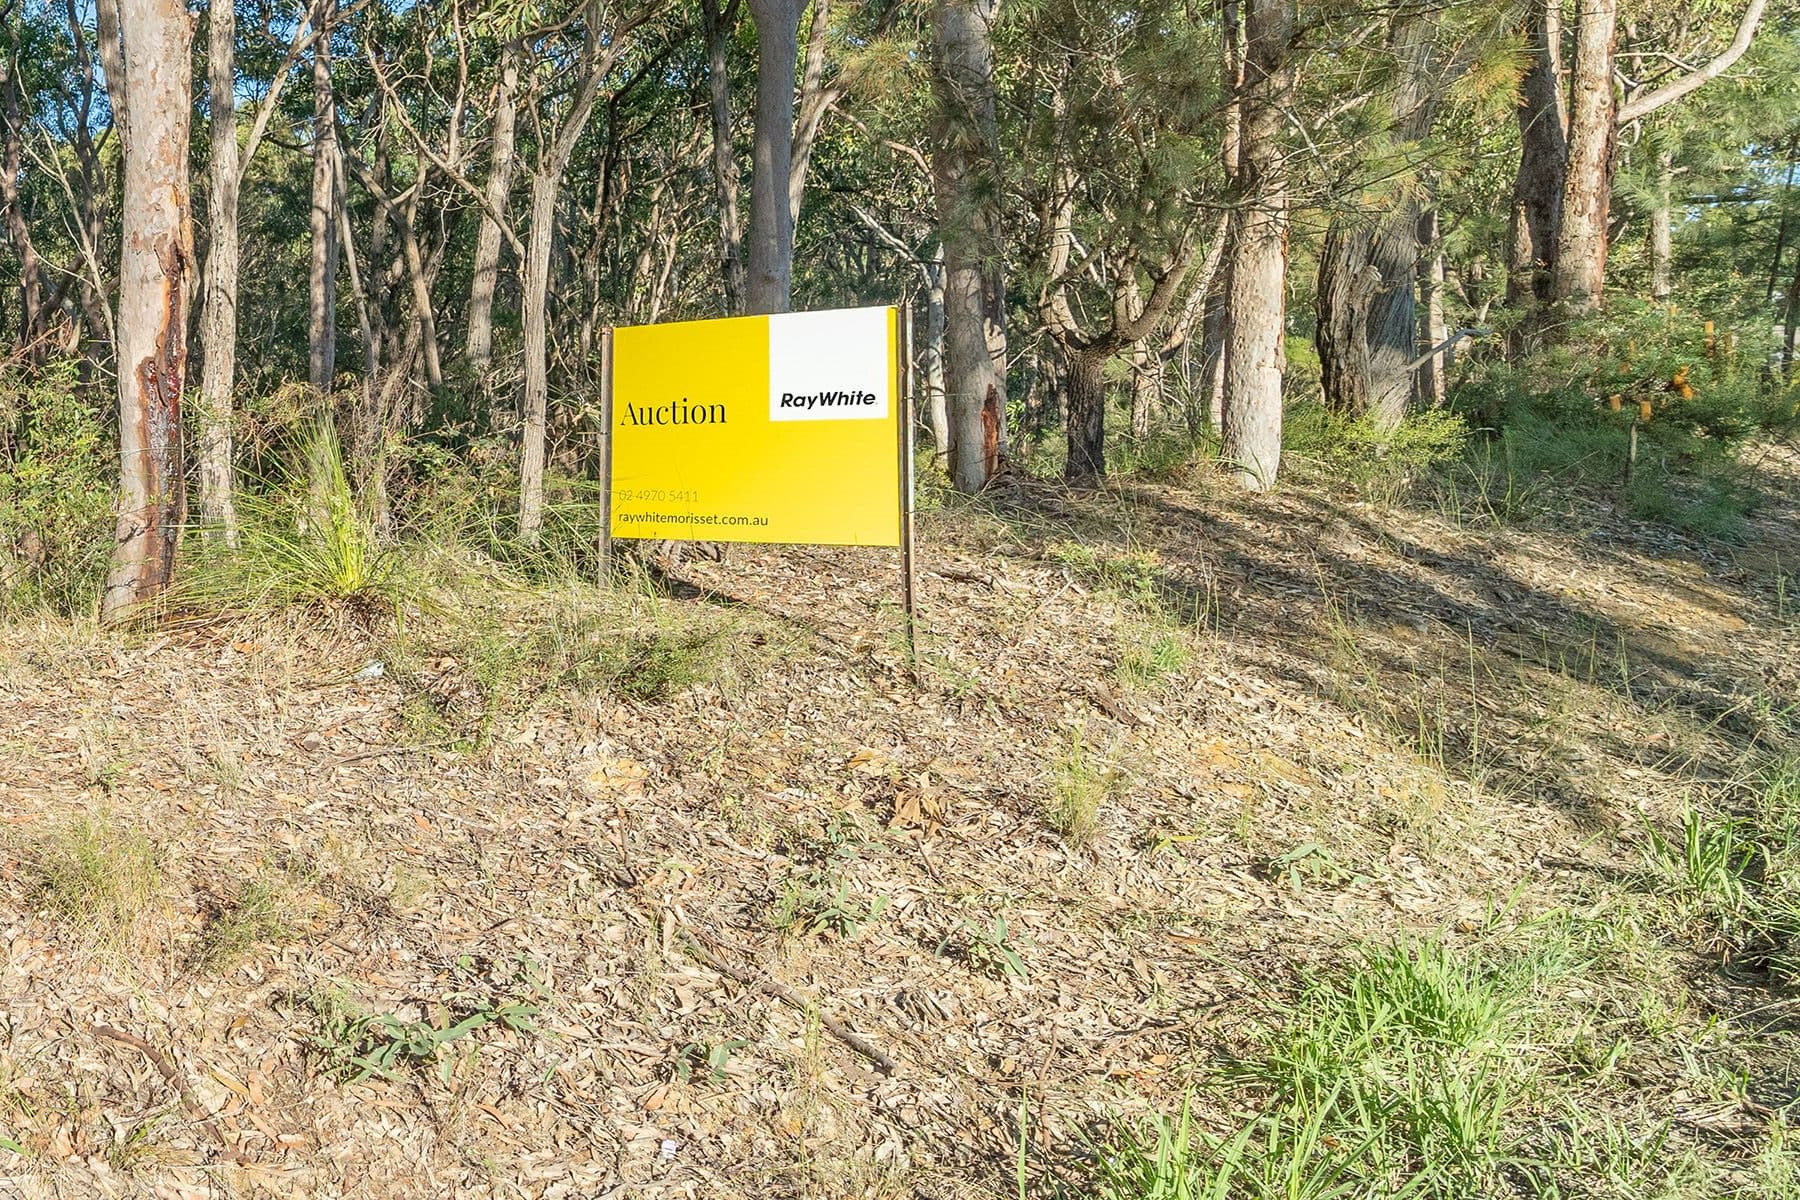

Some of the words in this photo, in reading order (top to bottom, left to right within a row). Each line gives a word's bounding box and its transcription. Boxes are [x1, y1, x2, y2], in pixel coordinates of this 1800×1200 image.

[620, 397, 727, 426] Auction
[618, 489, 633, 502] 02
[635, 489, 666, 502] 4970
[668, 490, 699, 503] 5411
[618, 511, 769, 527] raywhitemorisset.com.au
